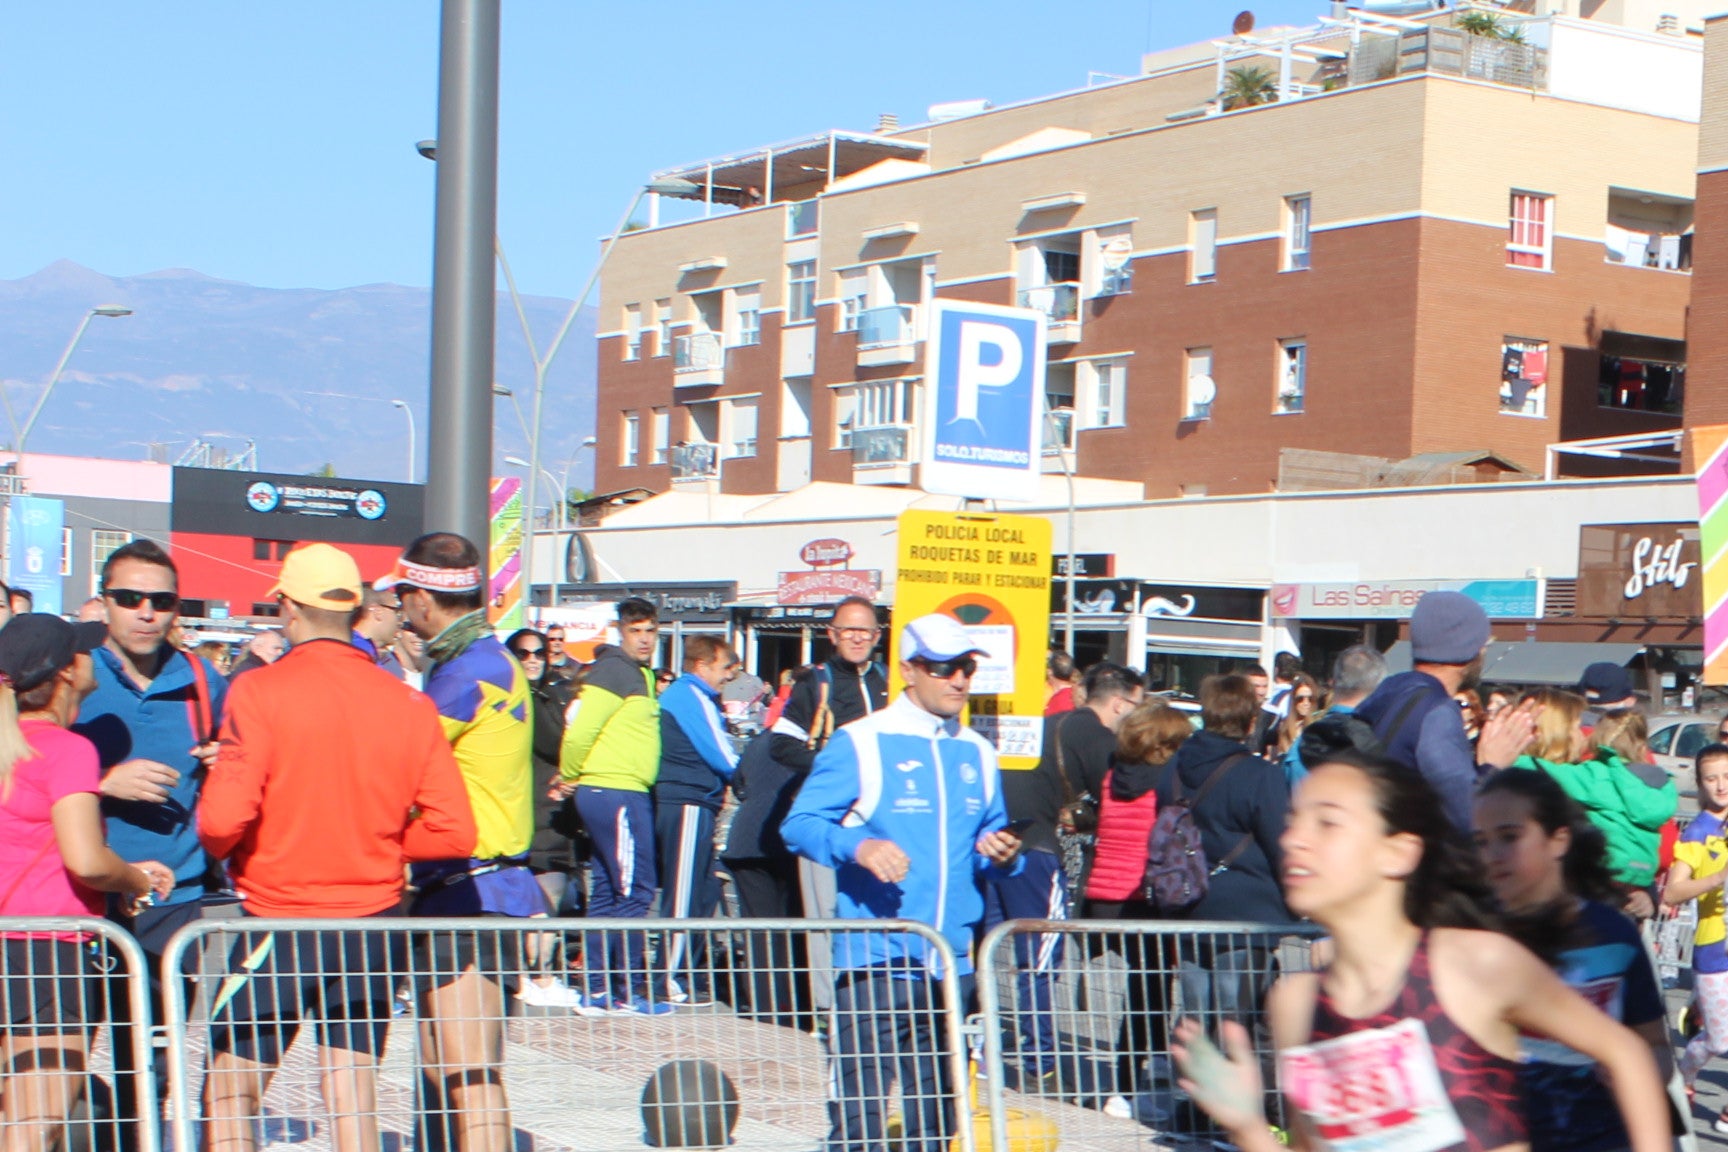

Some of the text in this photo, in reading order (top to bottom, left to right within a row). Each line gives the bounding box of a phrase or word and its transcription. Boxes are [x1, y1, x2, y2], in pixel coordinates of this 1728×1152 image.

[957, 321, 1023, 420] P
[926, 524, 1025, 544] POLICIA LOCAL
[910, 546, 1037, 566] ROQUETAS DE MAR
[406, 568, 477, 586] COMPRE
[898, 569, 1047, 589] PROHIBIDO PARAR Y ESTACIONAR
[1311, 585, 1349, 606] Las
